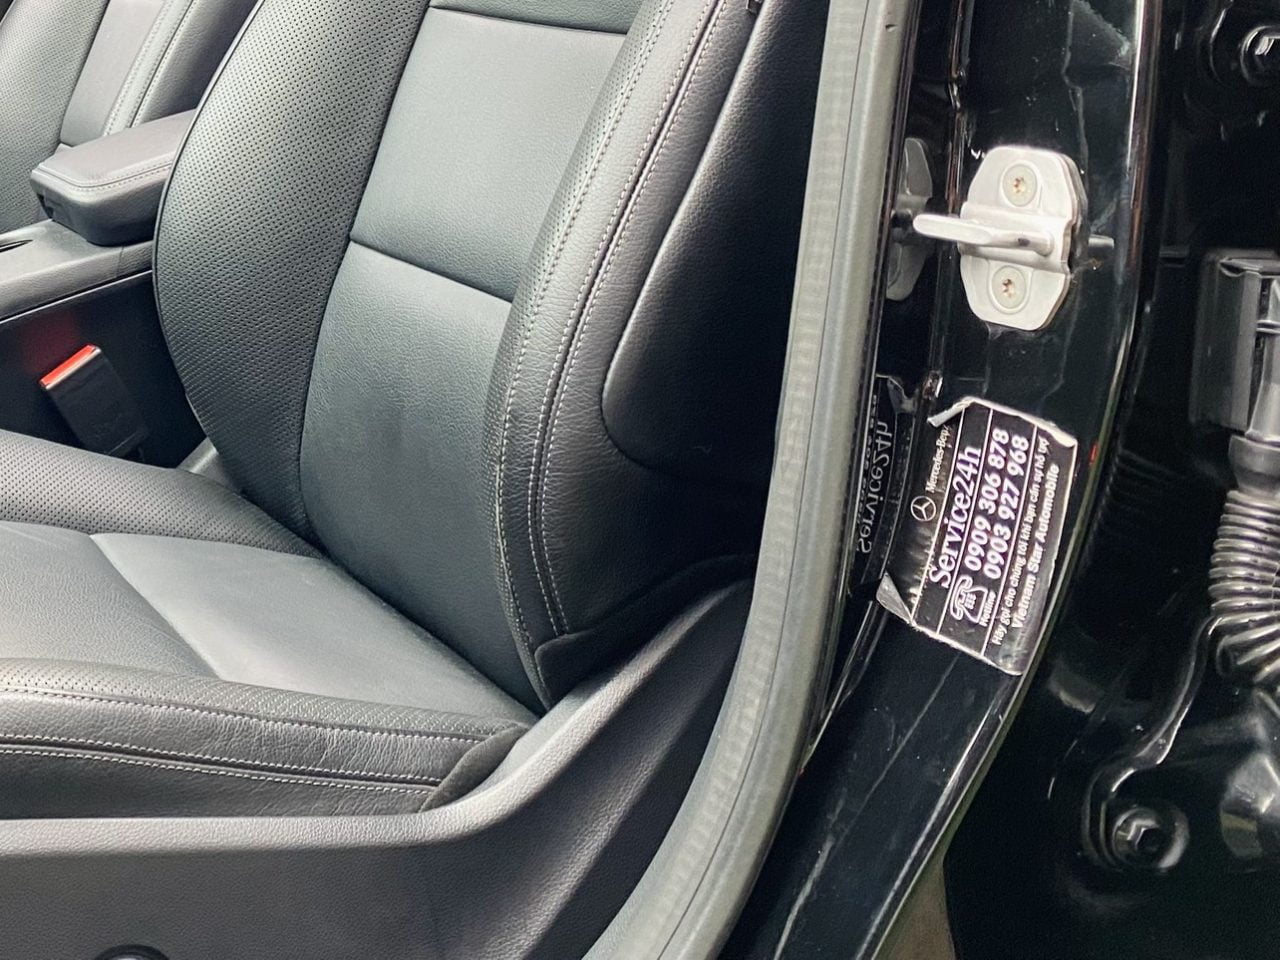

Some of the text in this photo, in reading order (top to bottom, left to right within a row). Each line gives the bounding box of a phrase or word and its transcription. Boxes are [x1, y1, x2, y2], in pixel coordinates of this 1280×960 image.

[927, 447, 981, 589] Service24h
[963, 427, 1010, 570] 0909 306 878
[983, 435, 1028, 578] 0903 927 968
[1011, 463, 1060, 628] Vietnam Star Automobile
[979, 589, 996, 627] Hotline
[1004, 587, 1016, 608] cho
